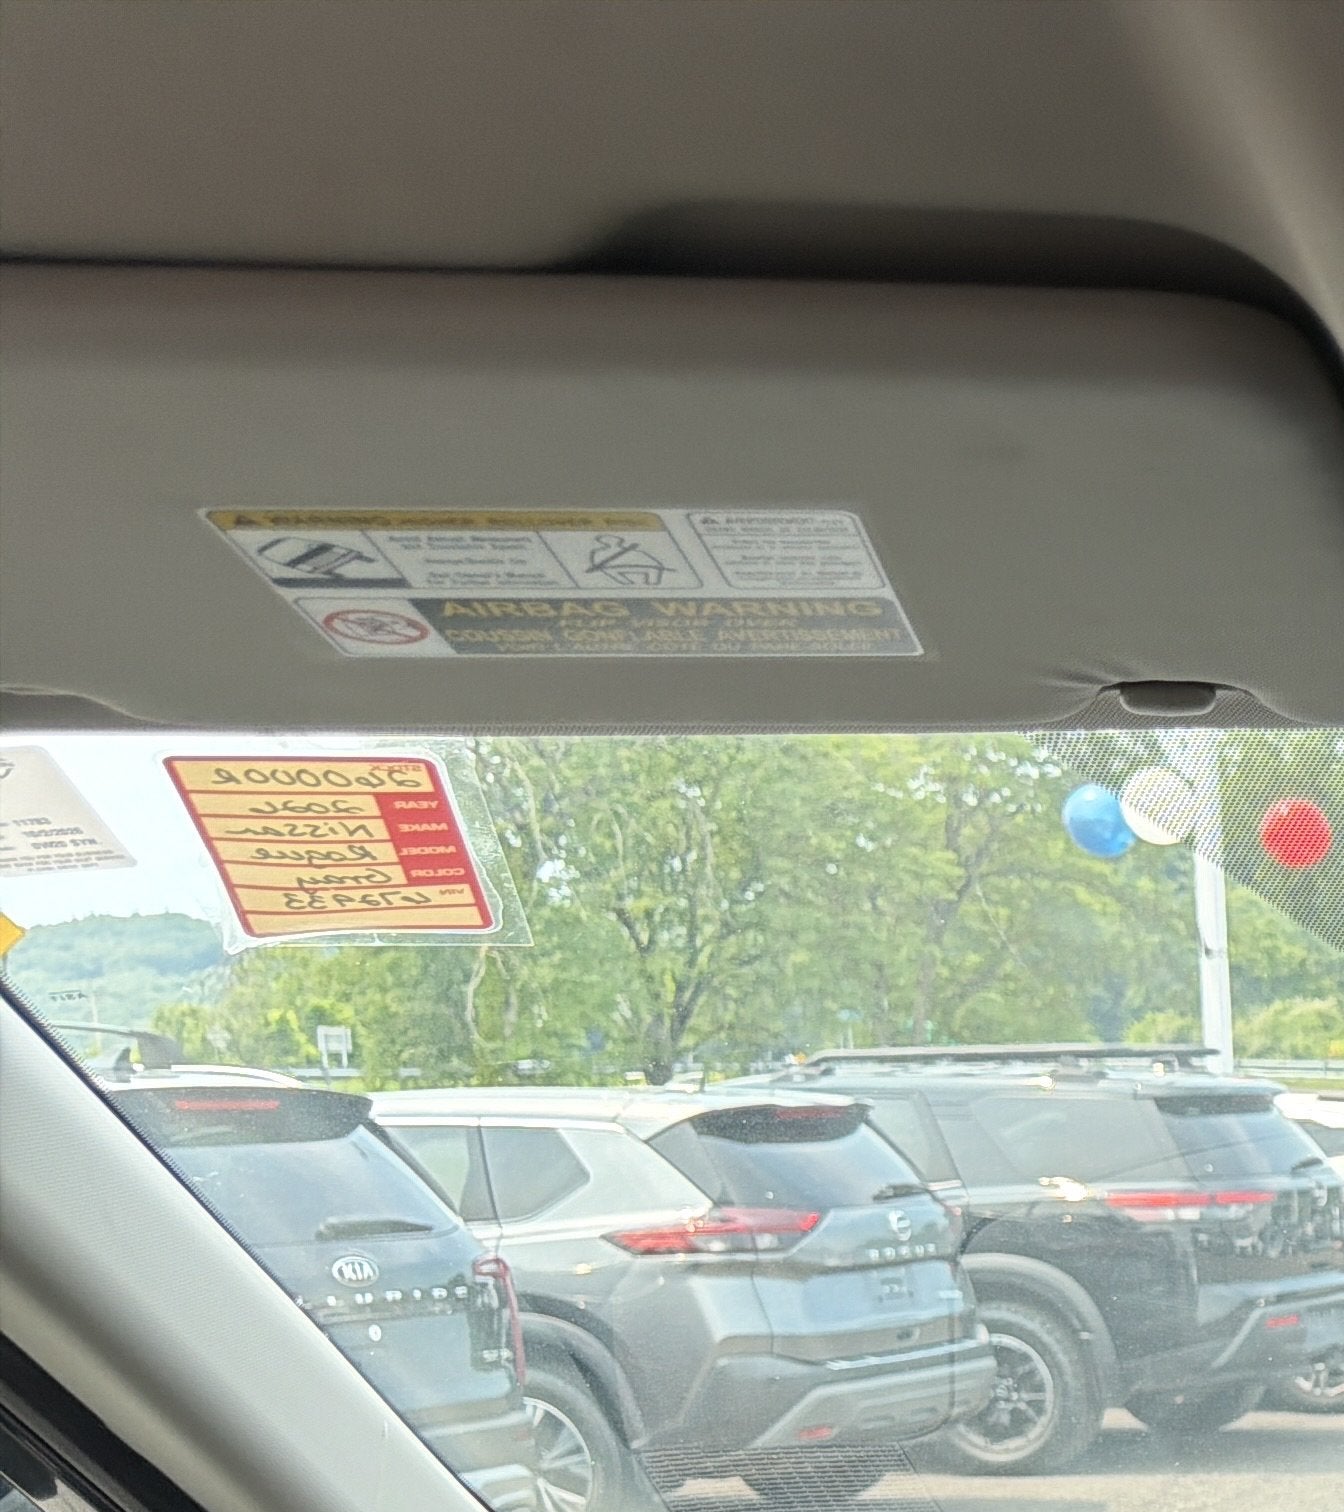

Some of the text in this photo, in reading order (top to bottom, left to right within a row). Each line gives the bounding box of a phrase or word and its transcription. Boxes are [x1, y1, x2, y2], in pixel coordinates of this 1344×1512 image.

[442, 600, 882, 617] AIRBAG WARNING
[340, 1262, 375, 1281] KIA
